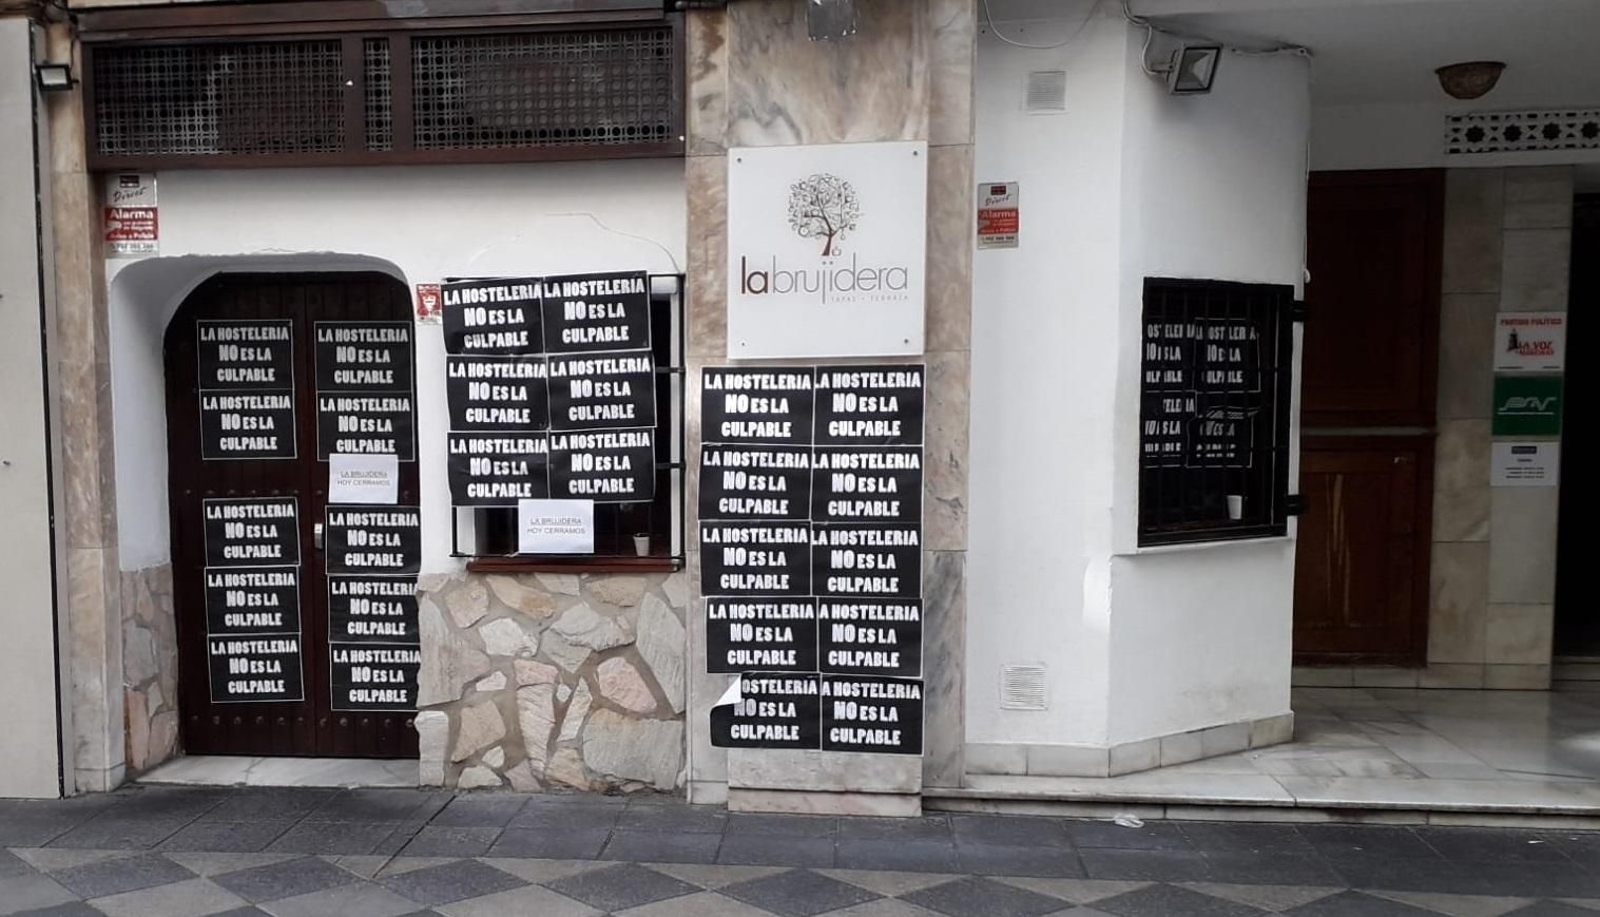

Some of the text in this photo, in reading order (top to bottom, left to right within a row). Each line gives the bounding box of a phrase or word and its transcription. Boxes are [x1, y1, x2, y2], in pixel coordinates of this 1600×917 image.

[109, 208, 154, 220] Alarma
[981, 210, 1016, 219] Alarma
[444, 290, 461, 306] LA
[462, 284, 544, 304] HOSTELERIA
[544, 278, 645, 299] LA HOSTELERIA
[464, 307, 524, 326] NO ES LA
[564, 301, 625, 320] NO ES LA
[201, 327, 289, 342] LA HOSTELERIA
[318, 329, 408, 343] LA HOSTELERIA
[463, 331, 528, 348] CULPABLE
[562, 326, 629, 344] CULPABLE
[218, 345, 271, 362] NO ES LA
[336, 347, 390, 364] NO ES LA
[216, 368, 274, 382] CULPABLE
[450, 363, 547, 378] LA HOSTELERIA
[551, 358, 651, 377] LA HOSTELERIA
[334, 371, 393, 384] CULPABLE
[705, 374, 811, 390] LA HOSTELERIA
[833, 372, 921, 389] HOSTELERIA
[468, 383, 527, 401] NO ES LA
[570, 380, 631, 398] NO ES LA
[204, 396, 291, 410] LA HOSTELERIA
[320, 398, 410, 412] LA HOSTELERIA
[725, 394, 788, 413] NO ES LA
[833, 393, 898, 413] NO ES LA
[466, 409, 530, 423] CULPABLE
[568, 404, 634, 421] CULPABLE
[221, 414, 274, 430] NO ES LA
[338, 416, 392, 433] NO ES LA
[721, 422, 791, 437] CULPABLE
[828, 421, 900, 436] CULPABLE
[219, 437, 277, 450] CULPABLE
[336, 440, 395, 453] CULPABLE
[450, 438, 548, 454] LA HOSTELERIA
[551, 432, 650, 450] LA HOSTELERIA
[469, 458, 528, 475] NO ES LA
[570, 453, 630, 472] NO ES LA
[703, 452, 809, 469] LA HOSTELERIA
[832, 454, 920, 469] HOSTELERIA
[568, 478, 634, 494] CULPABLE
[723, 472, 786, 491] NO ES LA
[832, 474, 897, 493] NO ES LA
[467, 483, 531, 497] CULPABLE
[207, 506, 294, 520] LA HOSTELERIA
[719, 498, 788, 514] CULPABLE
[828, 501, 900, 516] CULPABLE
[329, 513, 418, 527] LA HOSTELERIA
[225, 523, 277, 539] NO ES LA
[347, 531, 400, 547] NO ES LA
[703, 528, 808, 544] LA HOSTELERIA
[831, 530, 918, 547] HOSTELERIA
[223, 545, 281, 558] CULPABLE
[723, 548, 786, 566] NO ES LA
[831, 550, 895, 569] NO ES LA
[344, 554, 403, 566] CULPABLE
[208, 573, 295, 588] LA HOSTELERIA
[720, 575, 789, 589] CULPABLE
[827, 577, 898, 593] CULPABLE
[226, 591, 278, 607] NO ES LA
[224, 613, 281, 626] CULPABLE
[709, 605, 814, 620] LA HOSTELERIA
[730, 624, 793, 642] NO ES LA
[211, 640, 298, 654] LA HOSTELERIA
[229, 658, 281, 673] NO ES LA
[334, 651, 420, 664] LA HOSTELERIA
[727, 650, 796, 665] CULPABLE
[351, 668, 404, 683] NO ES LA
[227, 680, 284, 693] CULPABLE
[349, 690, 407, 703] CULPABLE
